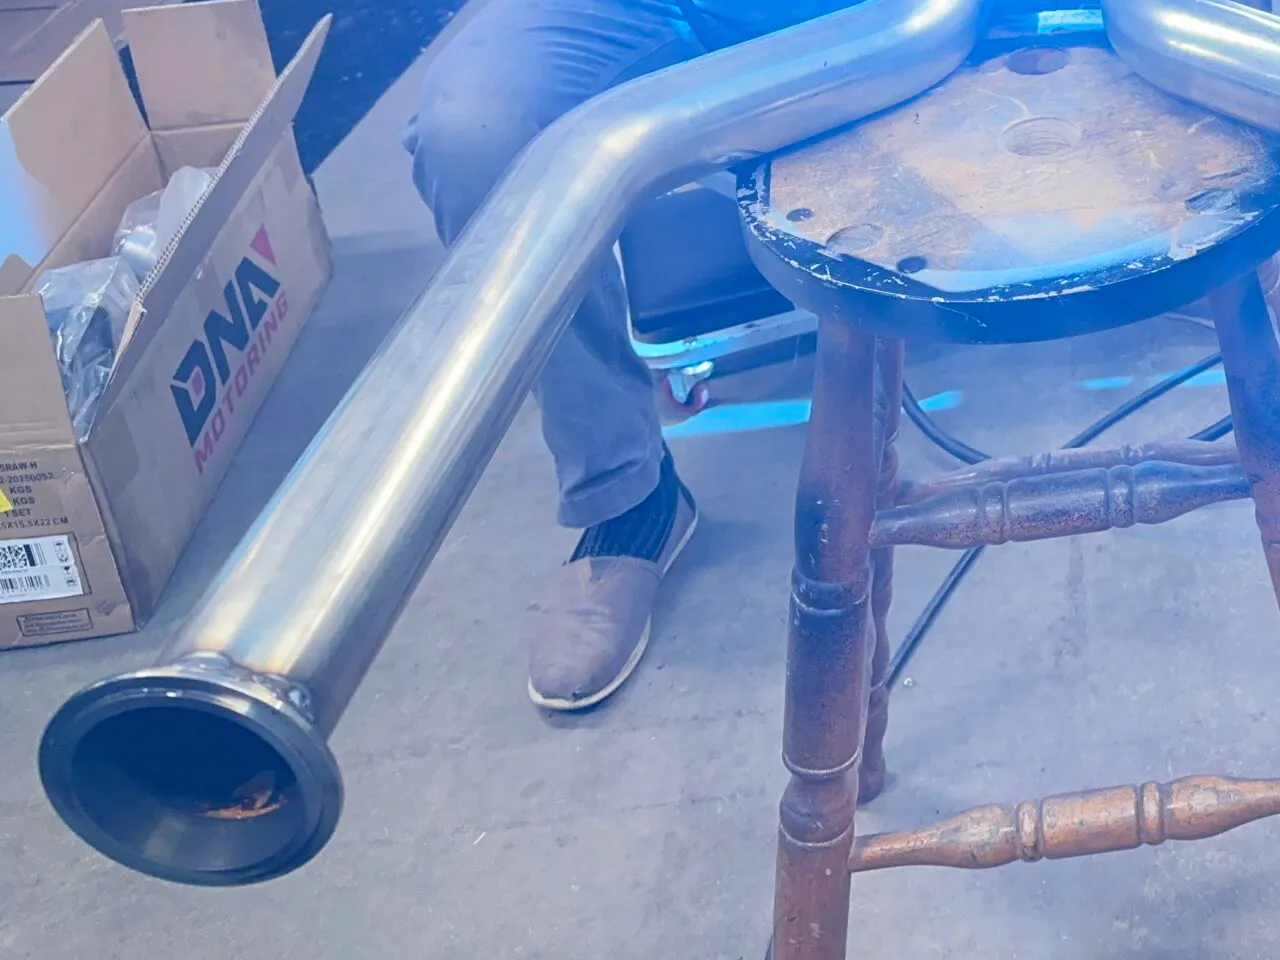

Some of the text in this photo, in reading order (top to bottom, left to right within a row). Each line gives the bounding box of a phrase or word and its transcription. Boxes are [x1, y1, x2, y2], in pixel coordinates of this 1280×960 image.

[170, 254, 281, 448] DNA
[193, 290, 290, 474] MOTORING
[9, 485, 32, 494] KGS
[12, 496, 36, 506] KGS
[12, 508, 31, 518] SET
[53, 516, 68, 526] CM
